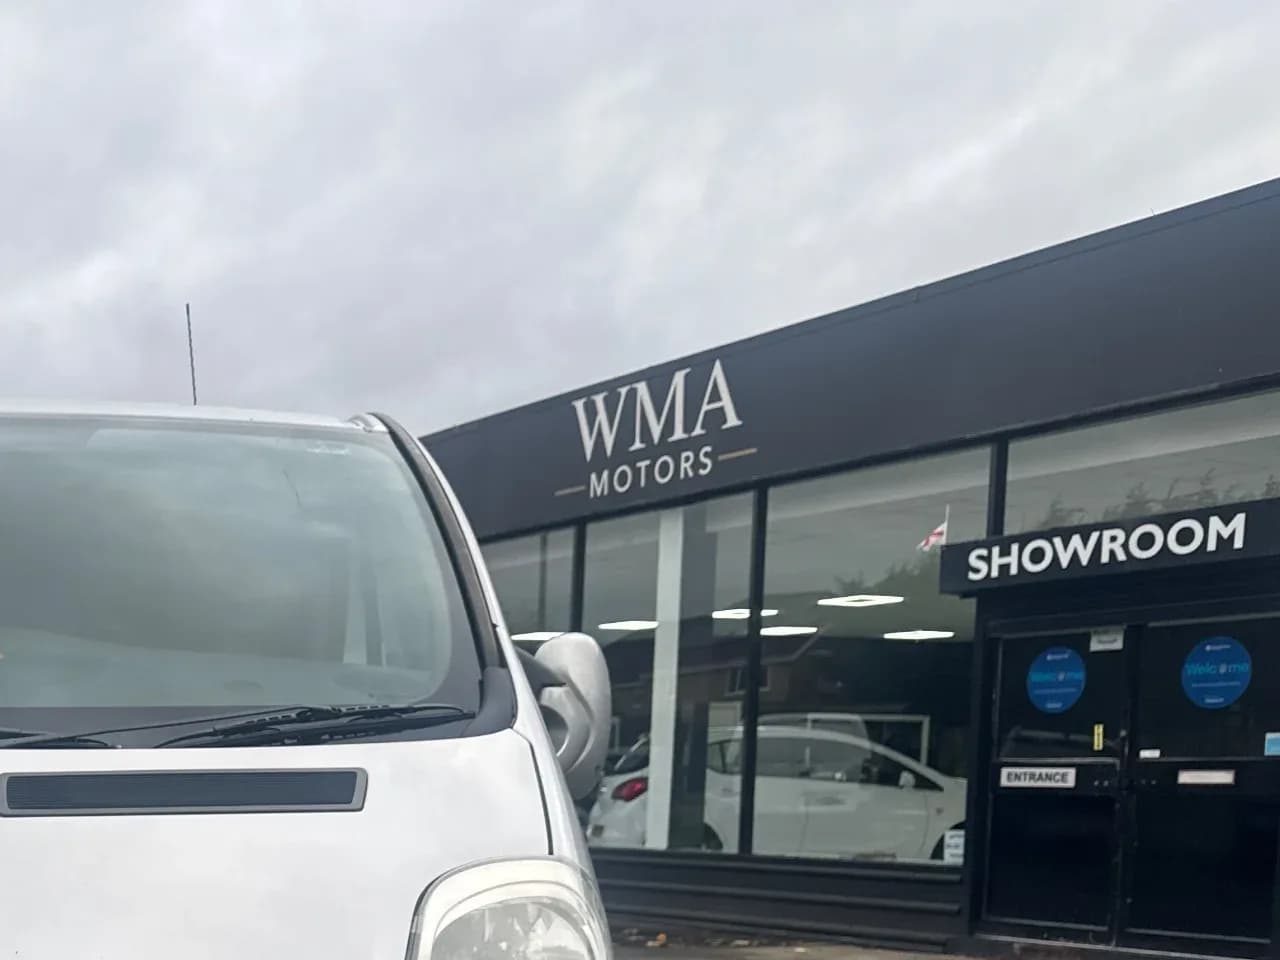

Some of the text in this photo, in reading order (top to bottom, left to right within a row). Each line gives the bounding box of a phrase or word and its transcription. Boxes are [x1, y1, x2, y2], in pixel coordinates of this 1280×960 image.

[572, 359, 742, 462] WMA
[589, 446, 713, 498] MOTORS
[968, 512, 1246, 581] SHOWROOM
[1007, 772, 1069, 784] ENTRANCE
